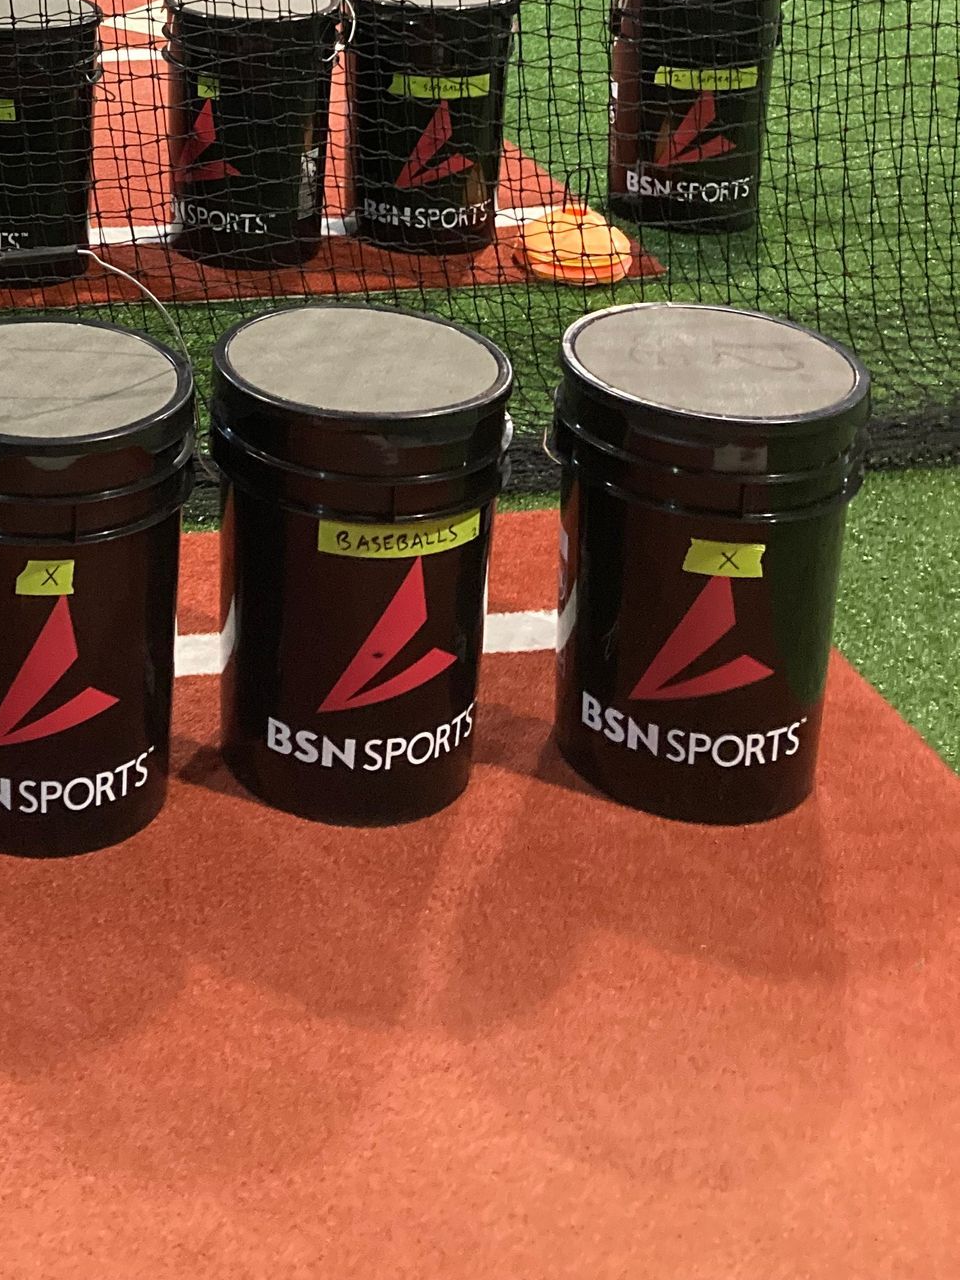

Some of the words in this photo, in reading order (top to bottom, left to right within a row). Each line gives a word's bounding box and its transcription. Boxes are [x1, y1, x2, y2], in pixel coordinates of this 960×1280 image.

[626, 170, 670, 196] BSN
[336, 524, 458, 552] BASEBALLS
[718, 550, 740, 570] X
[41, 565, 61, 586] X
[581, 690, 660, 757] BSN
[267, 716, 356, 770] BSN
